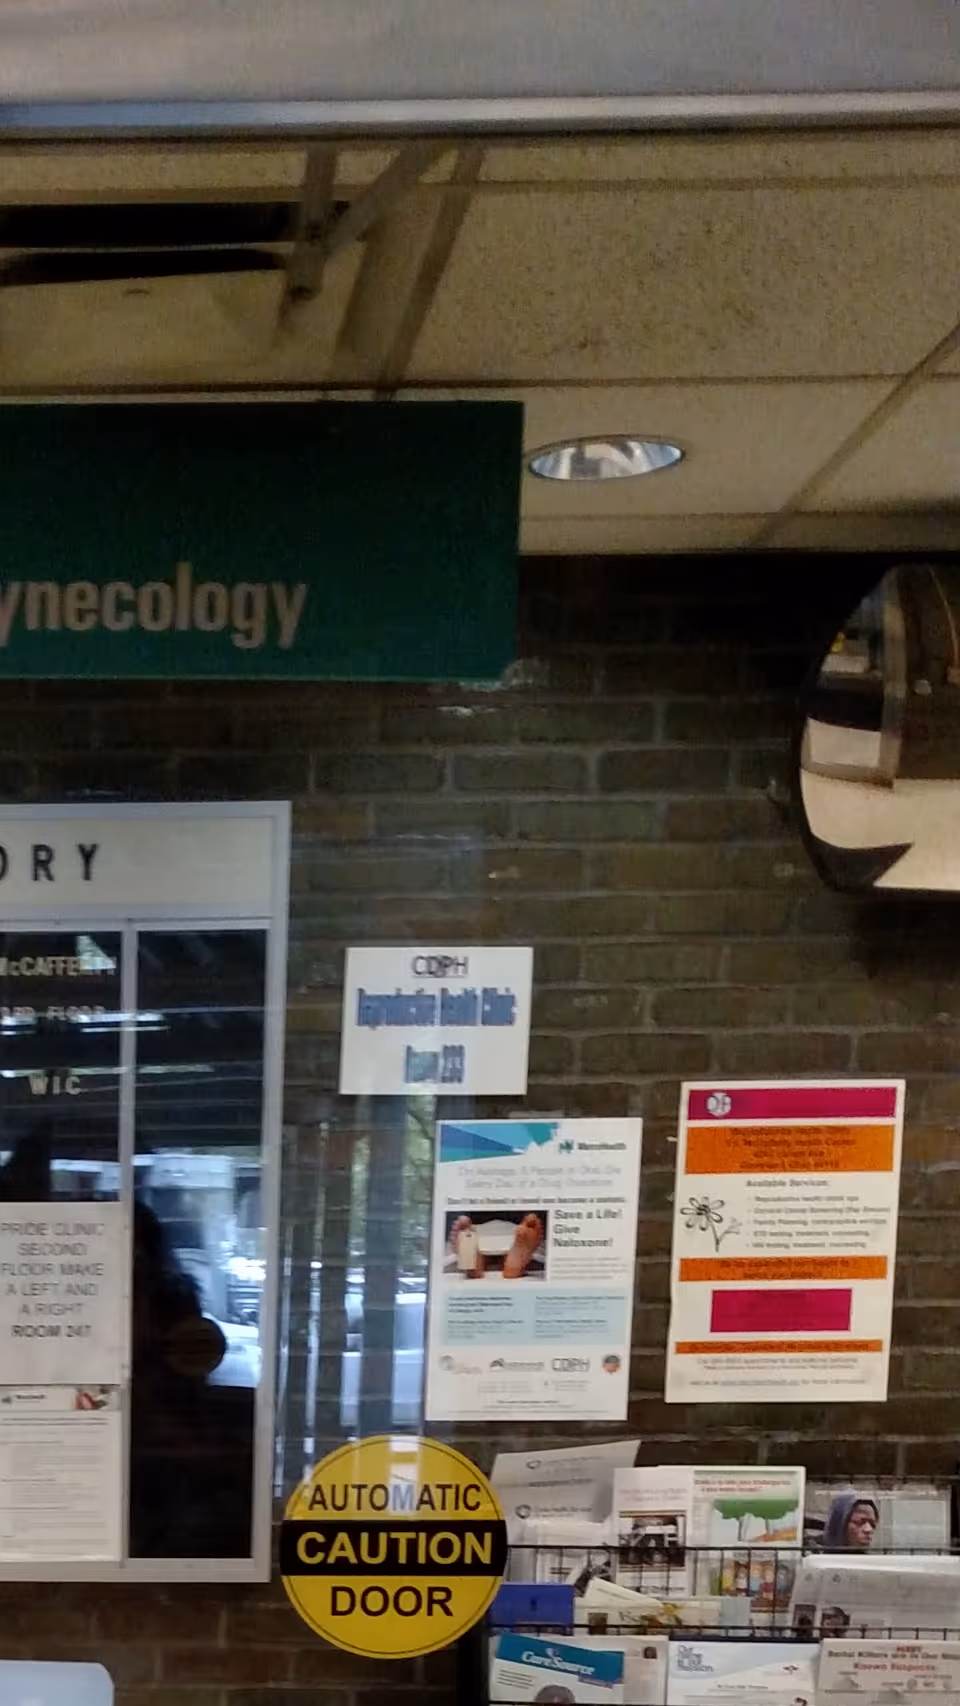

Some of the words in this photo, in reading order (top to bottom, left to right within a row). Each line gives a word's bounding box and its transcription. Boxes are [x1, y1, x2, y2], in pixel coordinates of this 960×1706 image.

[553, 1209, 583, 1220] Save
[0, 1221, 48, 1237] PRIDE
[52, 1221, 105, 1237] CLINIC
[552, 1224, 580, 1234] Give
[17, 1242, 88, 1257] SECOND
[0, 1262, 54, 1277] FLOOR
[59, 1262, 105, 1277] MAKE
[6, 1283, 17, 1296] A
[21, 1283, 59, 1296] LEFT
[64, 1282, 99, 1296] AND
[20, 1303, 30, 1315] A
[34, 1302, 84, 1316] RIGHT
[10, 1324, 61, 1338] ROOM
[308, 1483, 482, 1512] AUTOMATIC
[296, 1531, 493, 1566] CAUTION
[330, 1585, 455, 1618] DOOR
[520, 1650, 596, 1676] CareSource
